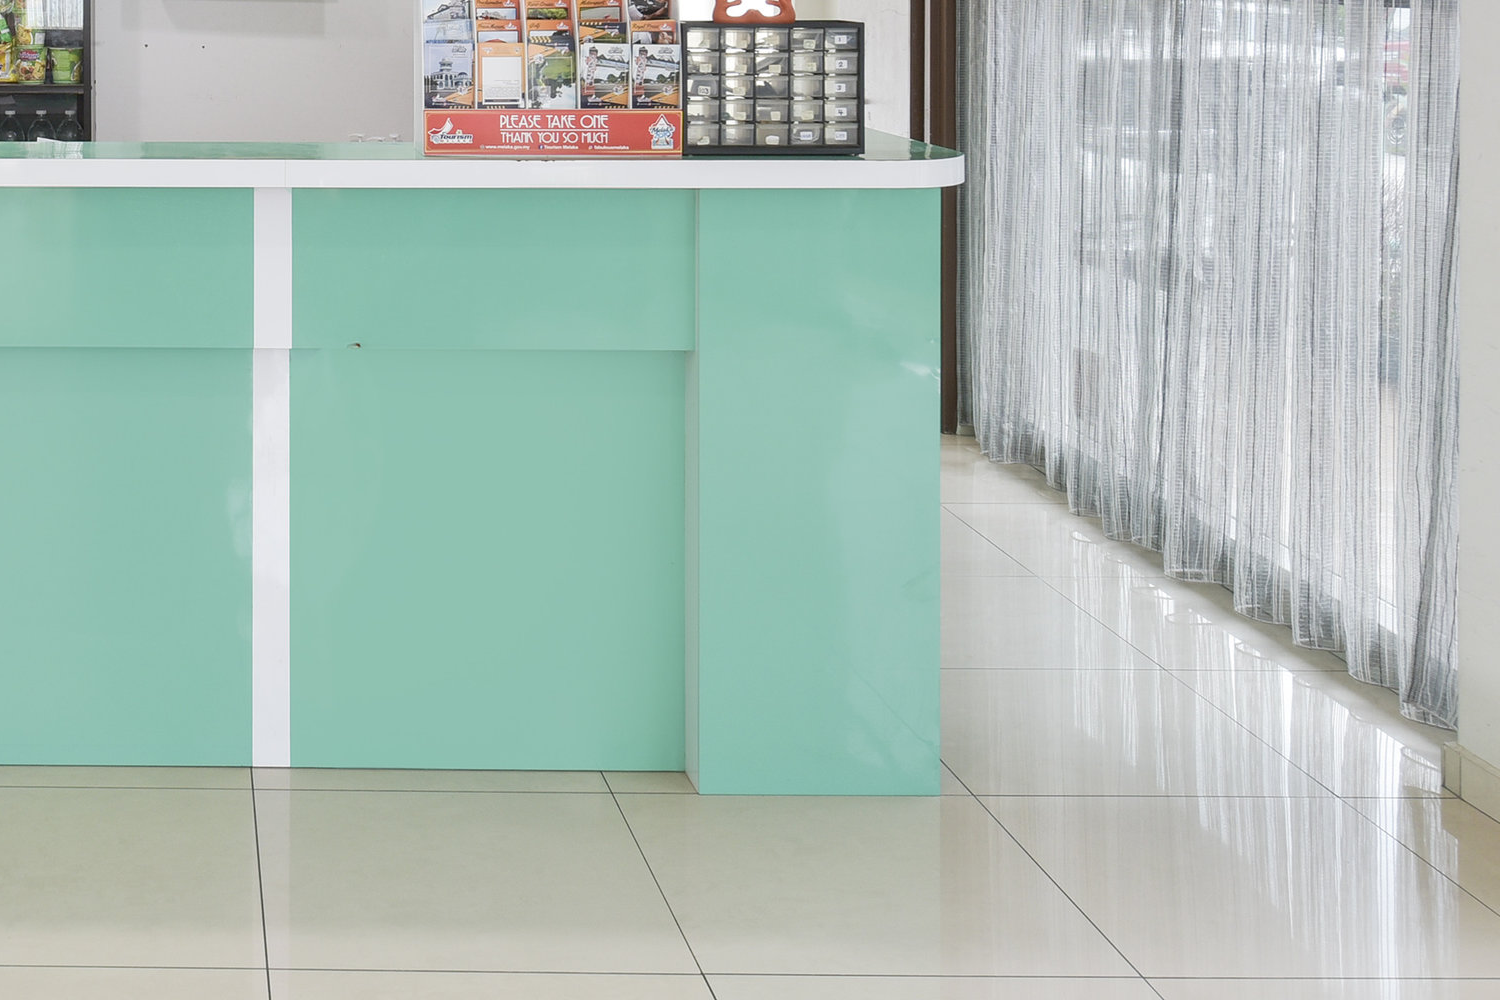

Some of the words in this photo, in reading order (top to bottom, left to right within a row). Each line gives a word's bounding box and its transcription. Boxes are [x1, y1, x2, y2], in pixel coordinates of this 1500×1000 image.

[499, 114, 541, 129] PLEASE
[545, 114, 576, 129] TAKE
[579, 114, 609, 129] ONE
[500, 132, 534, 144] THANK
[537, 132, 560, 144] YOU
[562, 132, 579, 144] SO
[581, 132, 609, 144] MUCH
